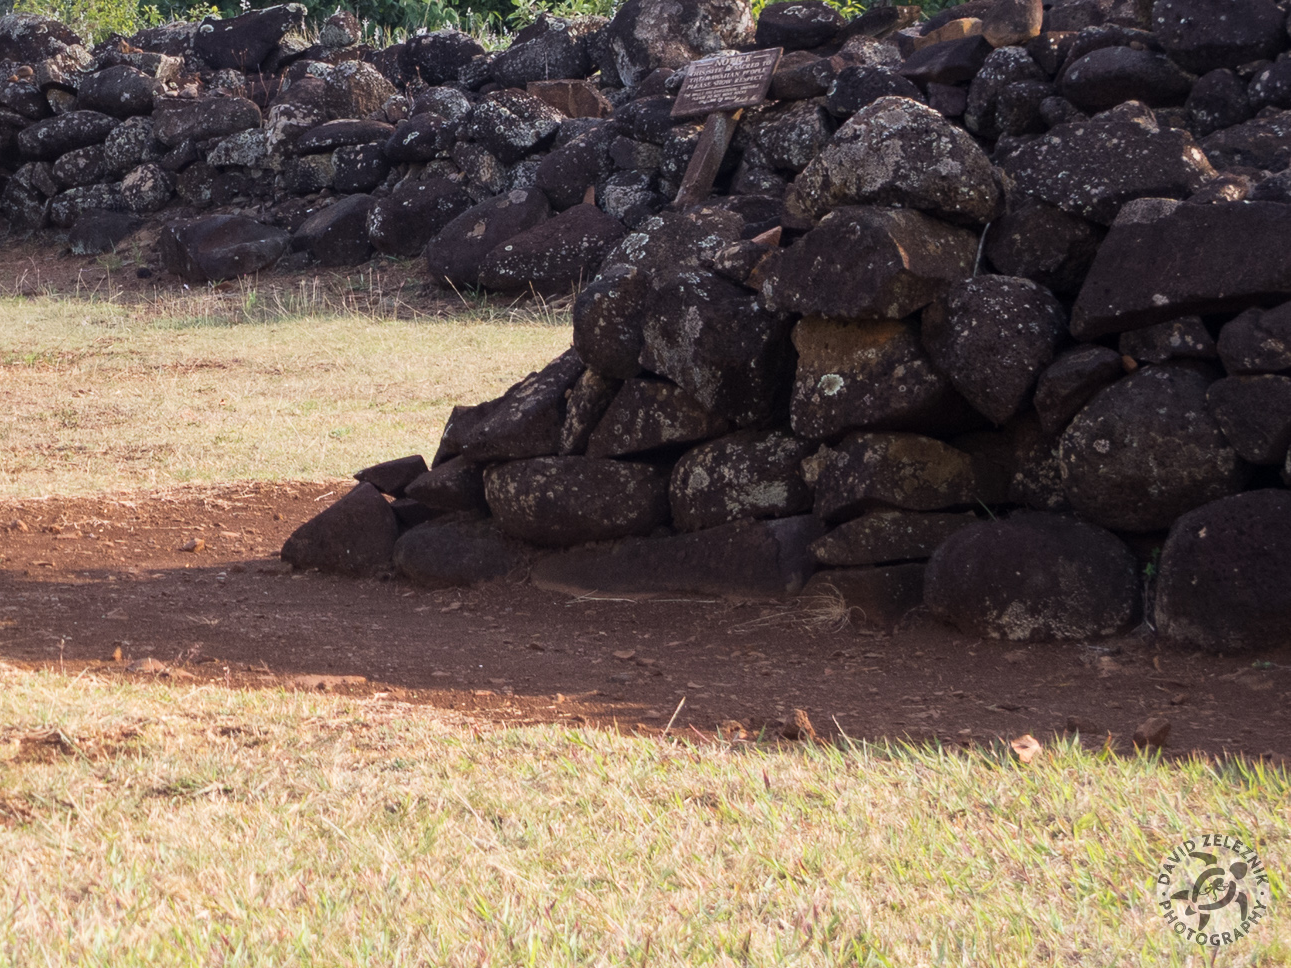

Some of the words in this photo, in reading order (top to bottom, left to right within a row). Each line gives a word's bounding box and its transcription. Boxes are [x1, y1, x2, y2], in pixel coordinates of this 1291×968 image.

[715, 55, 752, 66] NOTICE
[734, 62, 760, 70] SACRED
[743, 67, 767, 76] PEOPLE
[686, 82, 711, 90] PLEASE
[734, 74, 764, 83] RESPECT
